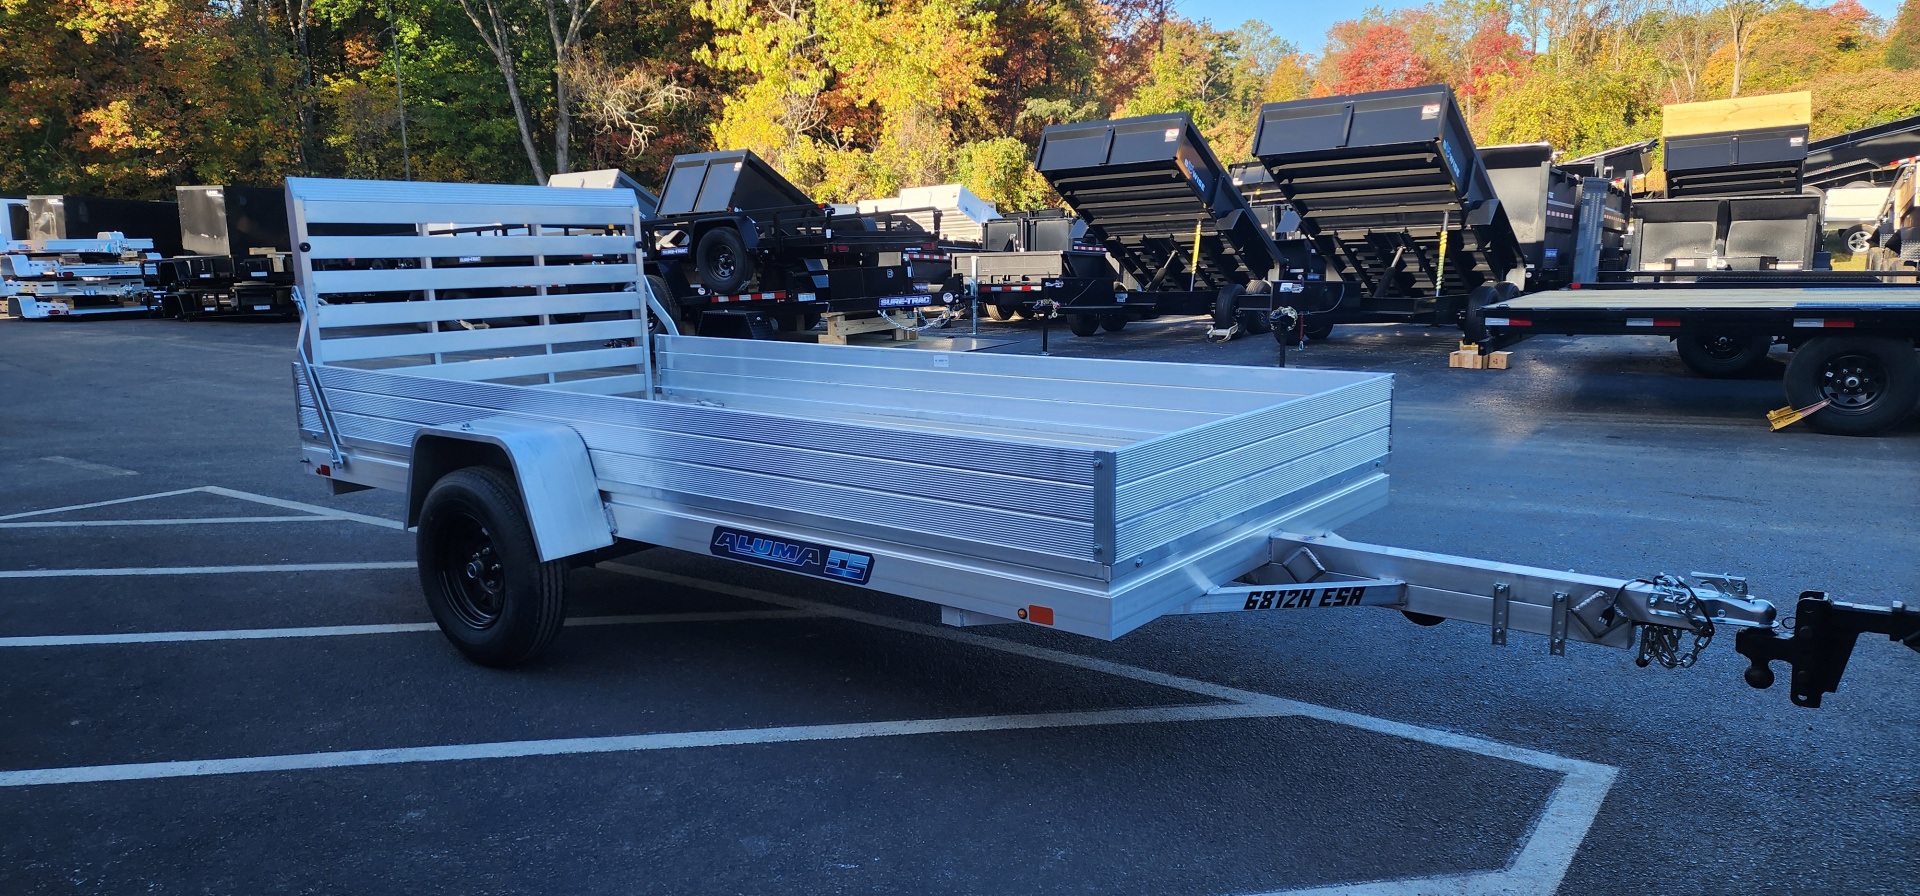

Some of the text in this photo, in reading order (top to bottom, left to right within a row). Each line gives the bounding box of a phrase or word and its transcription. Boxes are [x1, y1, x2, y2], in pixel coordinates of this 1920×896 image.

[880, 296, 930, 306] SURE-TRAC
[715, 532, 820, 567] ALUMA
[1243, 586, 1367, 610] 6812H ESA
